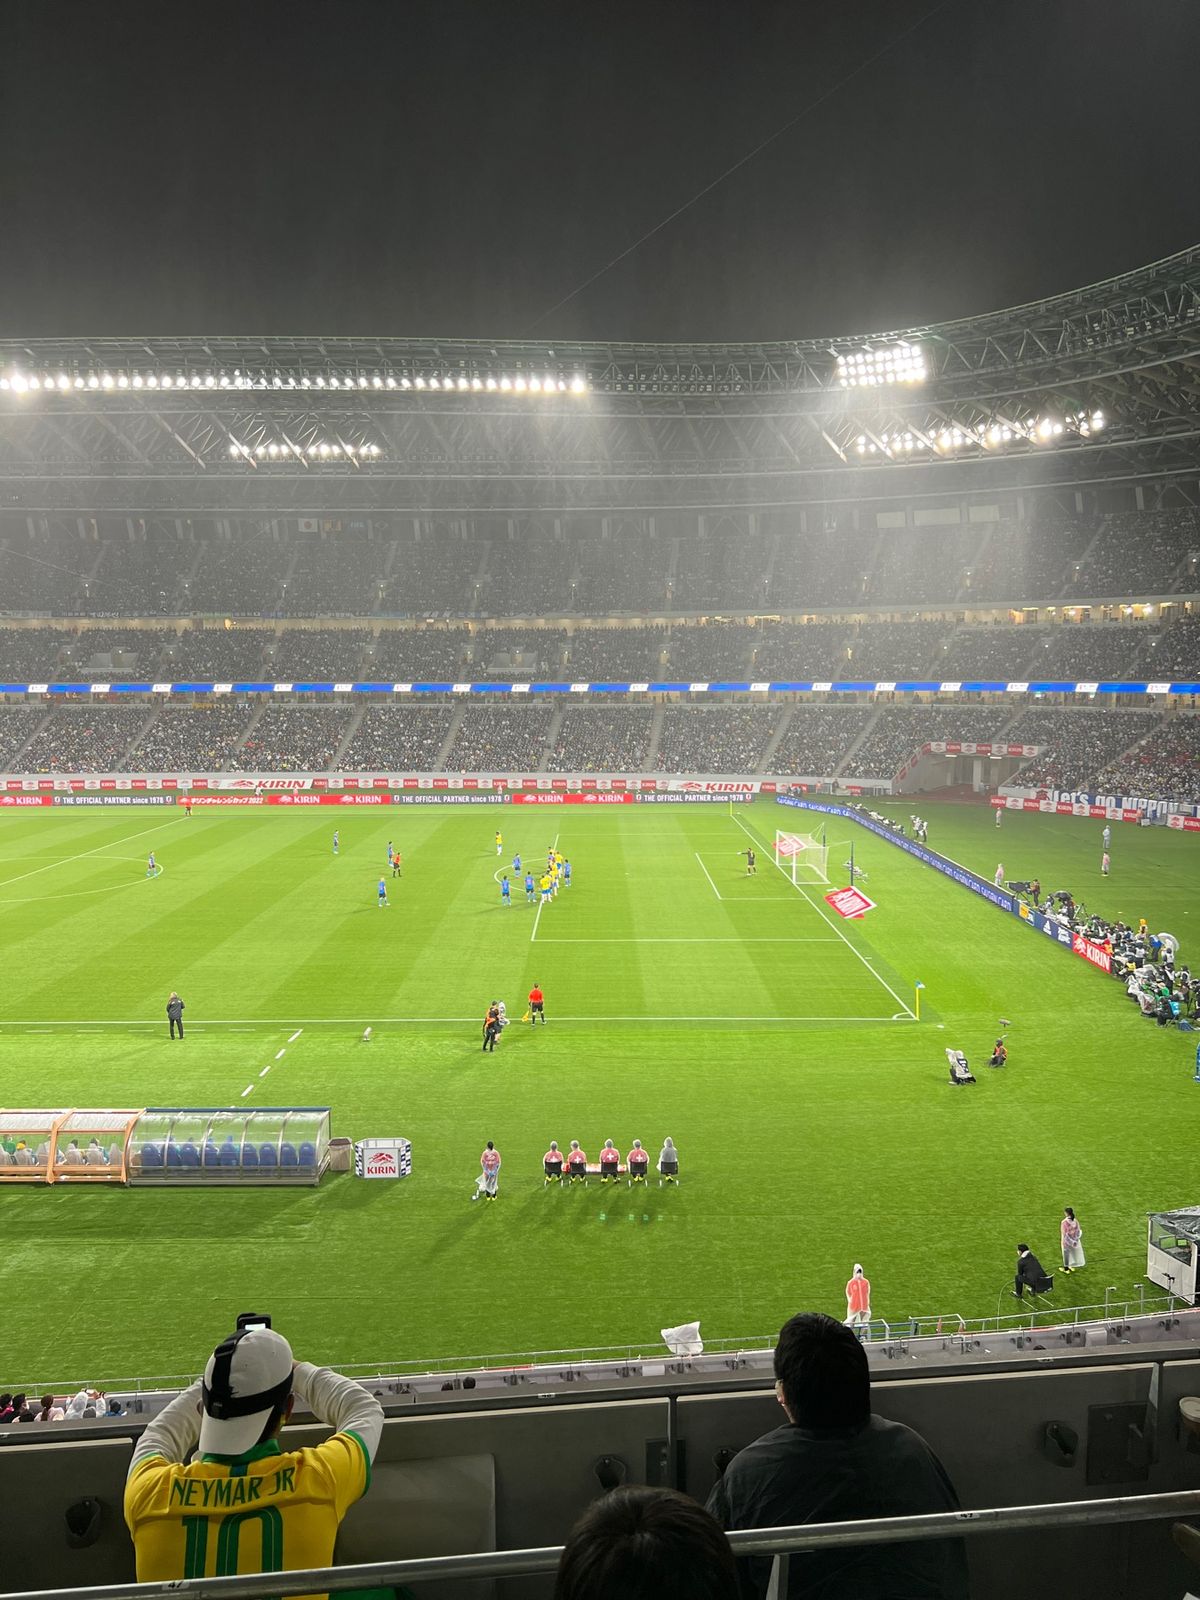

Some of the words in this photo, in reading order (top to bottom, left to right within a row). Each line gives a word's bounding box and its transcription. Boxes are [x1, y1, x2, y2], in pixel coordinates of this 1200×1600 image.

[705, 783, 754, 791] KIRIN
[1086, 943, 1110, 971] KIRIN
[367, 1166, 396, 1175] KIRIN
[169, 1477, 264, 1507] NEYMAR
[269, 1467, 295, 1496] JR
[181, 1505, 283, 1579] 10
